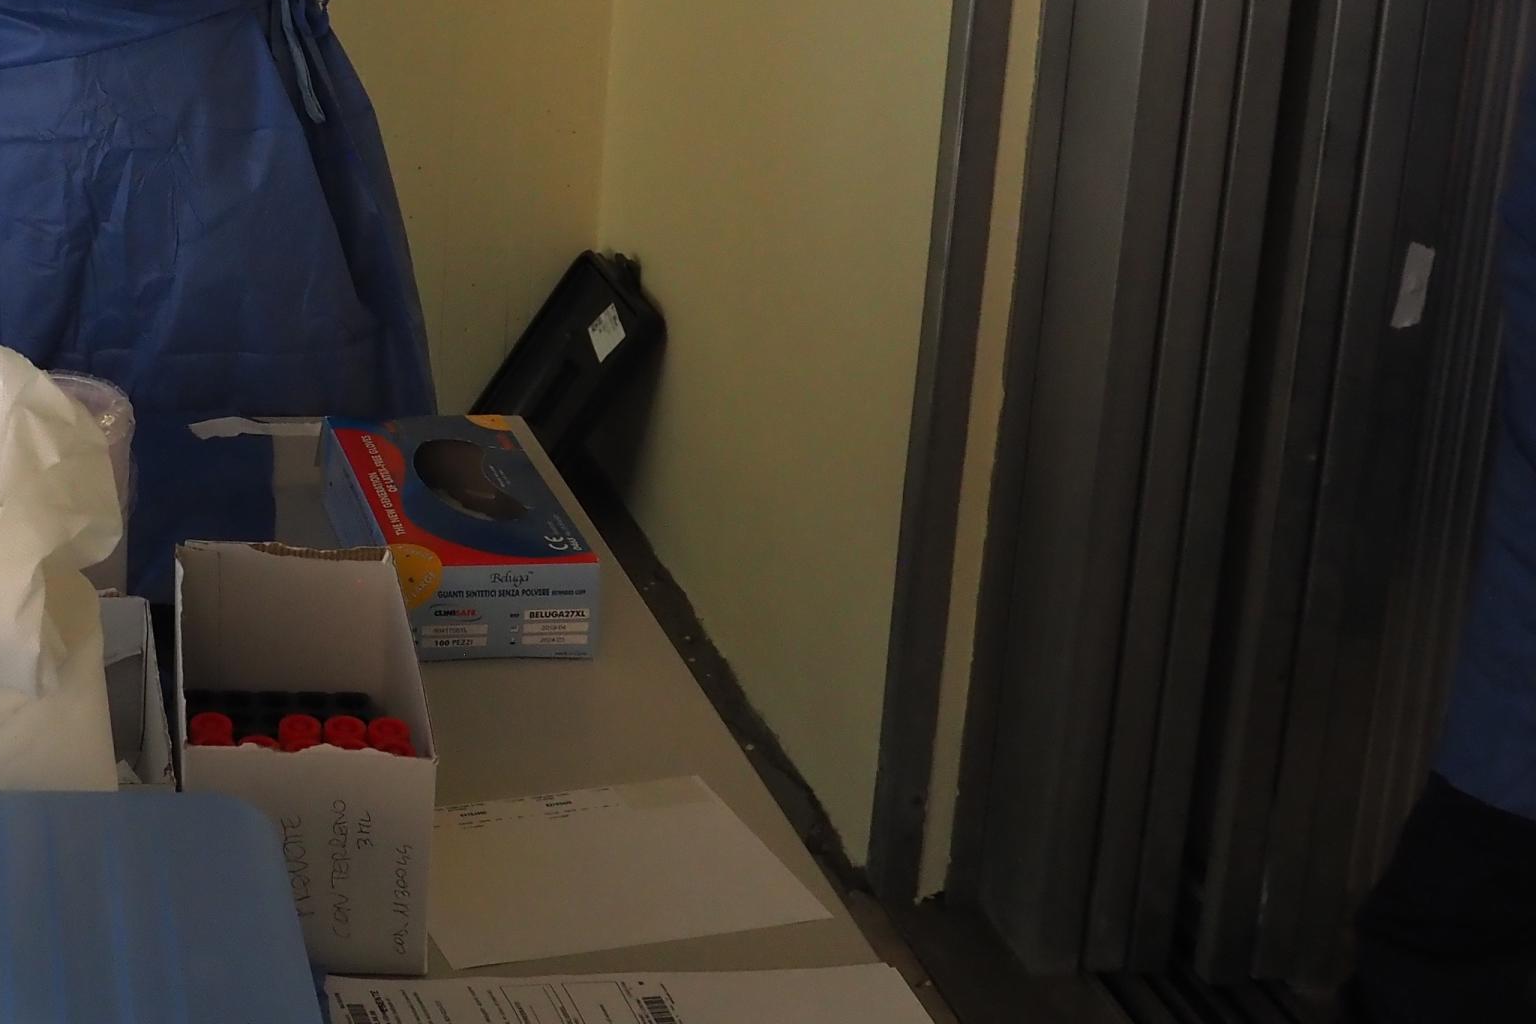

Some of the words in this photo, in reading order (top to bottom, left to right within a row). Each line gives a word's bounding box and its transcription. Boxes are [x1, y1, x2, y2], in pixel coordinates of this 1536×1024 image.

[438, 590, 464, 599] GUANTI
[465, 589, 496, 599] SINTETICI
[498, 589, 520, 598] SENZA
[521, 588, 550, 597] POLVERE
[529, 610, 586, 619] BELUGA27XL
[434, 639, 450, 647] 100
[332, 892, 351, 939] CON
